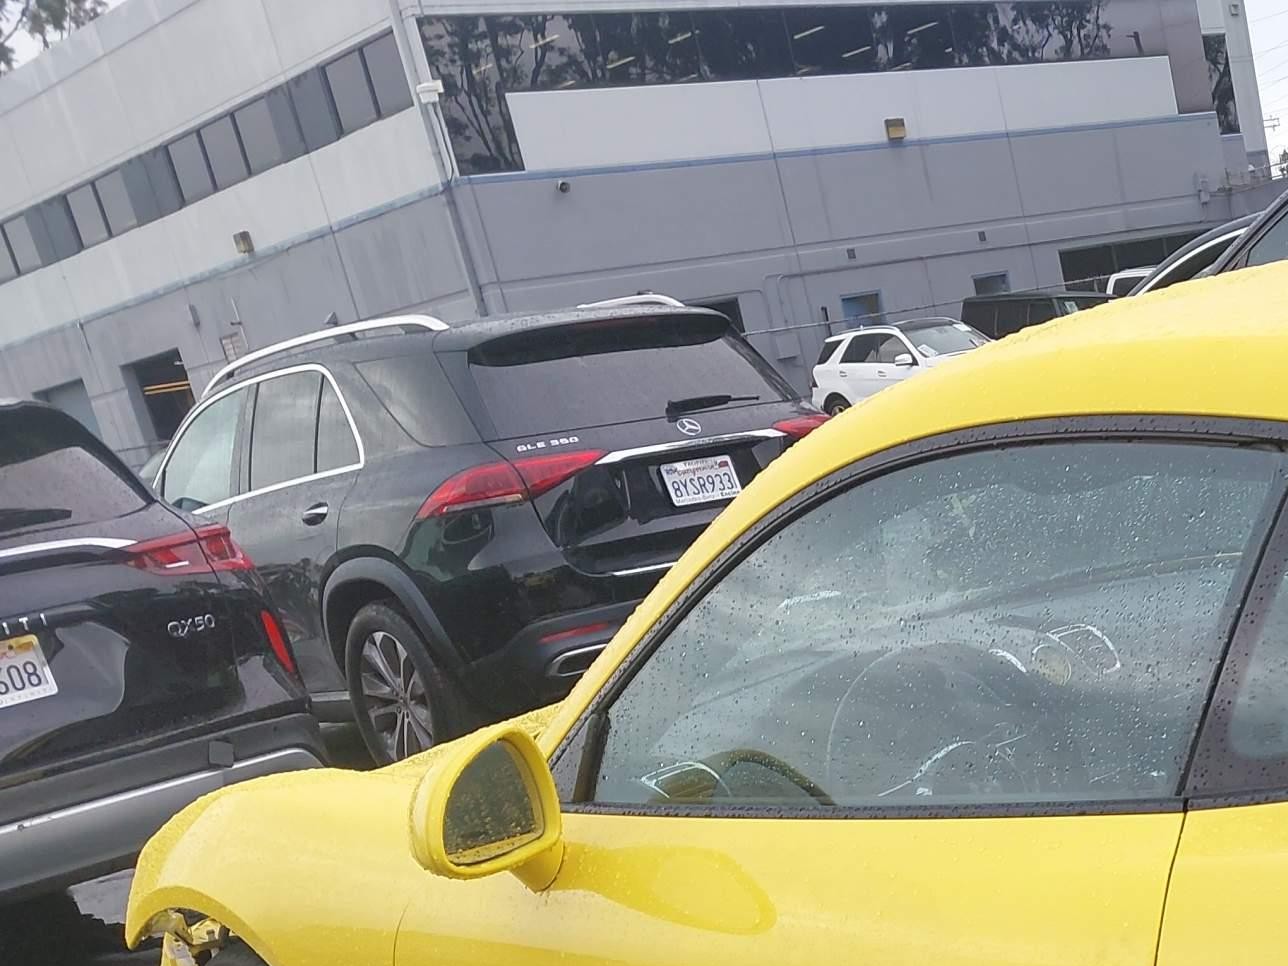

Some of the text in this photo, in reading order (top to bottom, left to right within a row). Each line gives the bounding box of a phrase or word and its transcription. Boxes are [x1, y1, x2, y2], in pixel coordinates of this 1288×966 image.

[516, 441, 546, 452] GLE
[671, 472, 734, 498] 8YSR933
[167, 613, 215, 637] QX50
